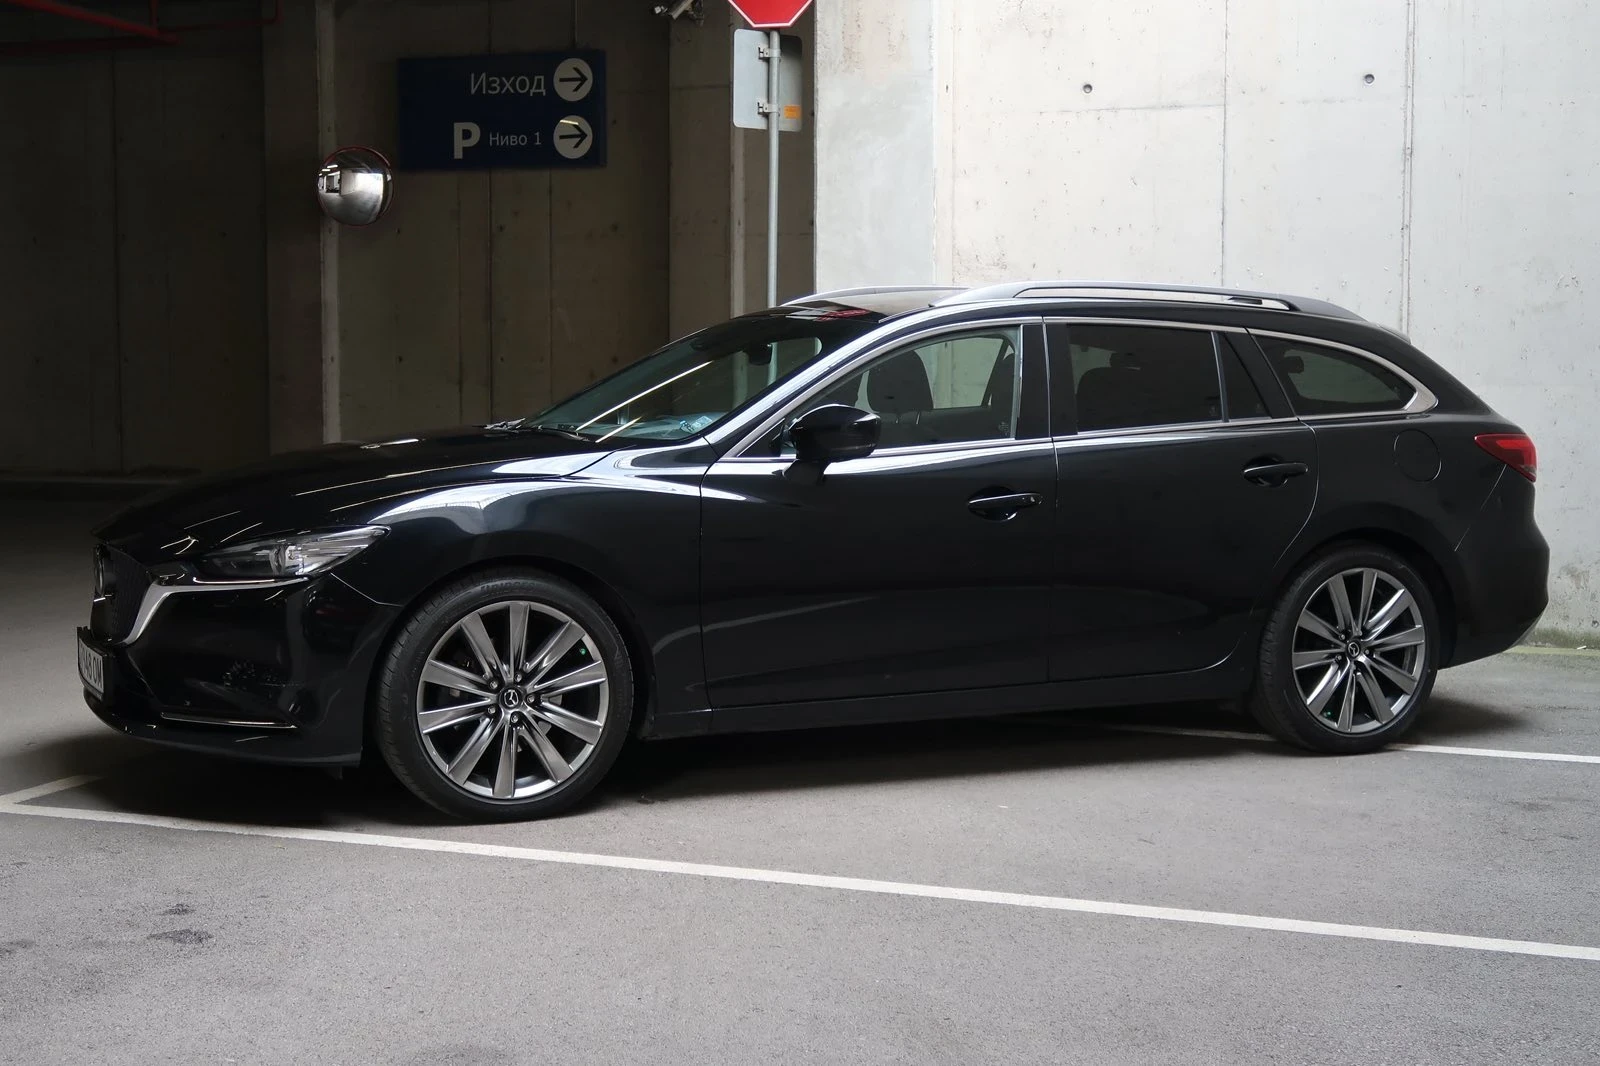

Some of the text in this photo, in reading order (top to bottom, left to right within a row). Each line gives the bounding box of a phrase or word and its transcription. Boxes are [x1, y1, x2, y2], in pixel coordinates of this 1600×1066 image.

[470, 72, 546, 97] Изход
[453, 122, 542, 160] P Ниво 1
